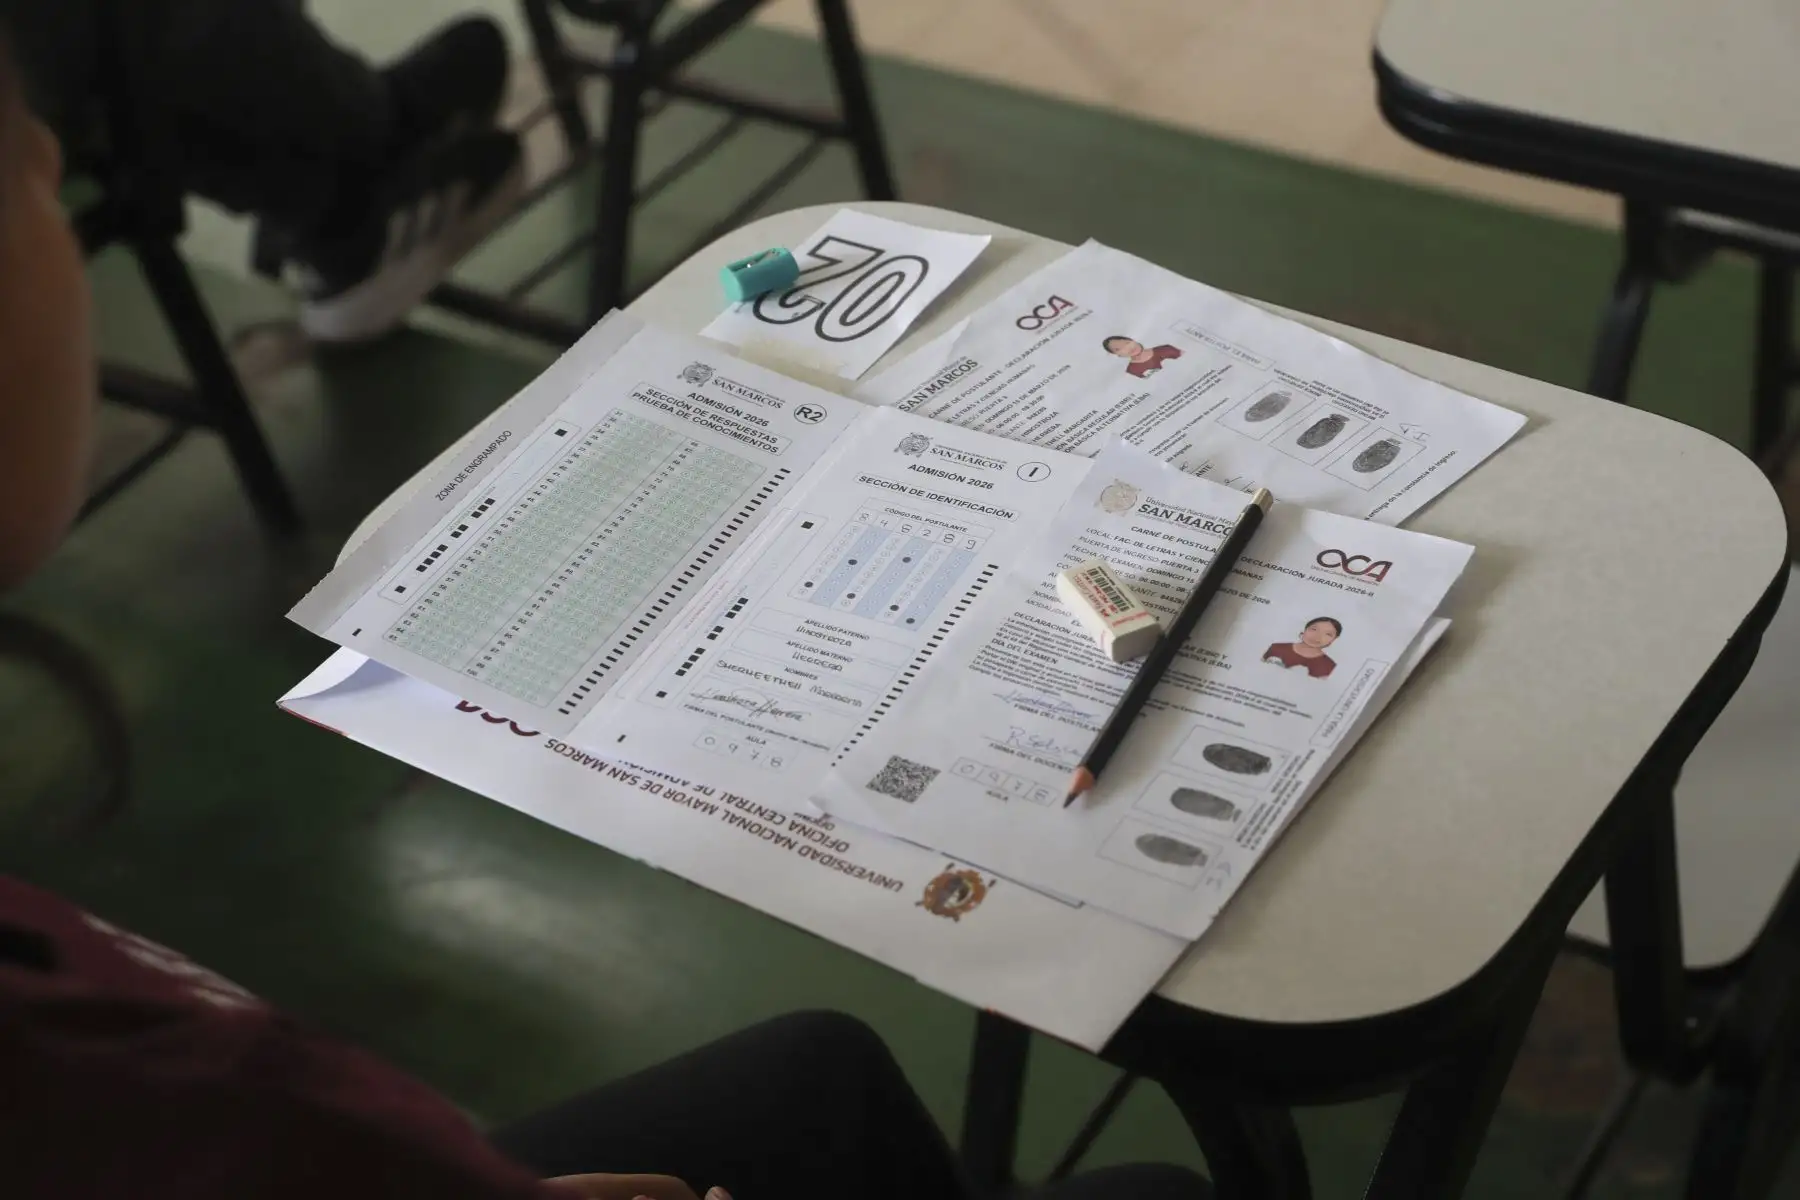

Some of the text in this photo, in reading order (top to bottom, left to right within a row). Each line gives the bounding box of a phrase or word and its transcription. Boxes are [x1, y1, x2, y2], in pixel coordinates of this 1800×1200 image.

[1016, 294, 1074, 330] OCA
[712, 378, 735, 391] SAN
[735, 384, 784, 409] MARCOS
[899, 392, 928, 412] SAN
[924, 359, 978, 394] MARCOS
[961, 370, 1001, 397] POSTULANTE
[632, 392, 779, 453] PRUEBA DE CONOCIMIENTOS
[646, 388, 691, 410] SECCIÓN
[692, 406, 708, 417] DE
[708, 412, 778, 444] RESPUESTAS
[688, 392, 769, 427] ADMISIÓN 2026
[796, 406, 823, 422] R2
[1063, 410, 1098, 434] MARGARITA
[435, 430, 512, 501] ZONA DE ENGRAMPADO
[929, 448, 953, 460] SAN
[954, 453, 1005, 471] MARCOS
[908, 463, 994, 490] ADMISIÓN 2026
[858, 475, 1013, 519] SECCIÓN DE IDENTIFICACIÓN
[1145, 496, 1218, 520] Universidad Nacional
[910, 513, 923, 523] DEL
[924, 518, 968, 533] POSTULANTE
[1138, 503, 1173, 519] SAN
[1175, 512, 1233, 536] MARCO
[943, 533, 955, 545] 8
[1079, 536, 1110, 550] PUERTA
[1110, 546, 1121, 554] DE
[1160, 560, 1191, 572] PUERTA
[1132, 541, 1146, 549] DE
[1146, 544, 1177, 557] LETRAS
[1185, 554, 1211, 566] CIENC
[1071, 544, 1097, 557] FECHA
[1146, 567, 1185, 582] DOMINGO
[1239, 591, 1252, 600] DE
[1131, 526, 1161, 538] CARNÉ
[1162, 534, 1176, 542] DE
[1176, 537, 1218, 553] POSTULA
[1240, 556, 1305, 579] DECLARACIÓN
[1307, 575, 1343, 590] JURADA
[1316, 549, 1394, 583] OCA
[804, 619, 870, 641] APELLIDO PATERNO
[786, 640, 853, 663] APELLIDO MATERNO
[1023, 649, 1058, 664] EXAMEN
[784, 667, 818, 681] NOMBRES
[705, 709, 718, 718] DEL
[720, 714, 765, 731] POSTULANTE
[746, 735, 766, 745] AULA
[544, 739, 608, 773] MARCOS
[607, 765, 643, 786] SAN
[640, 779, 665, 794] DE
[663, 787, 720, 816] MAYOR
[719, 791, 787, 825] CENTRAL
[721, 809, 799, 850] NACIONAL
[788, 819, 850, 853] OFICINA
[798, 845, 904, 893] UNIVERSIDAD
